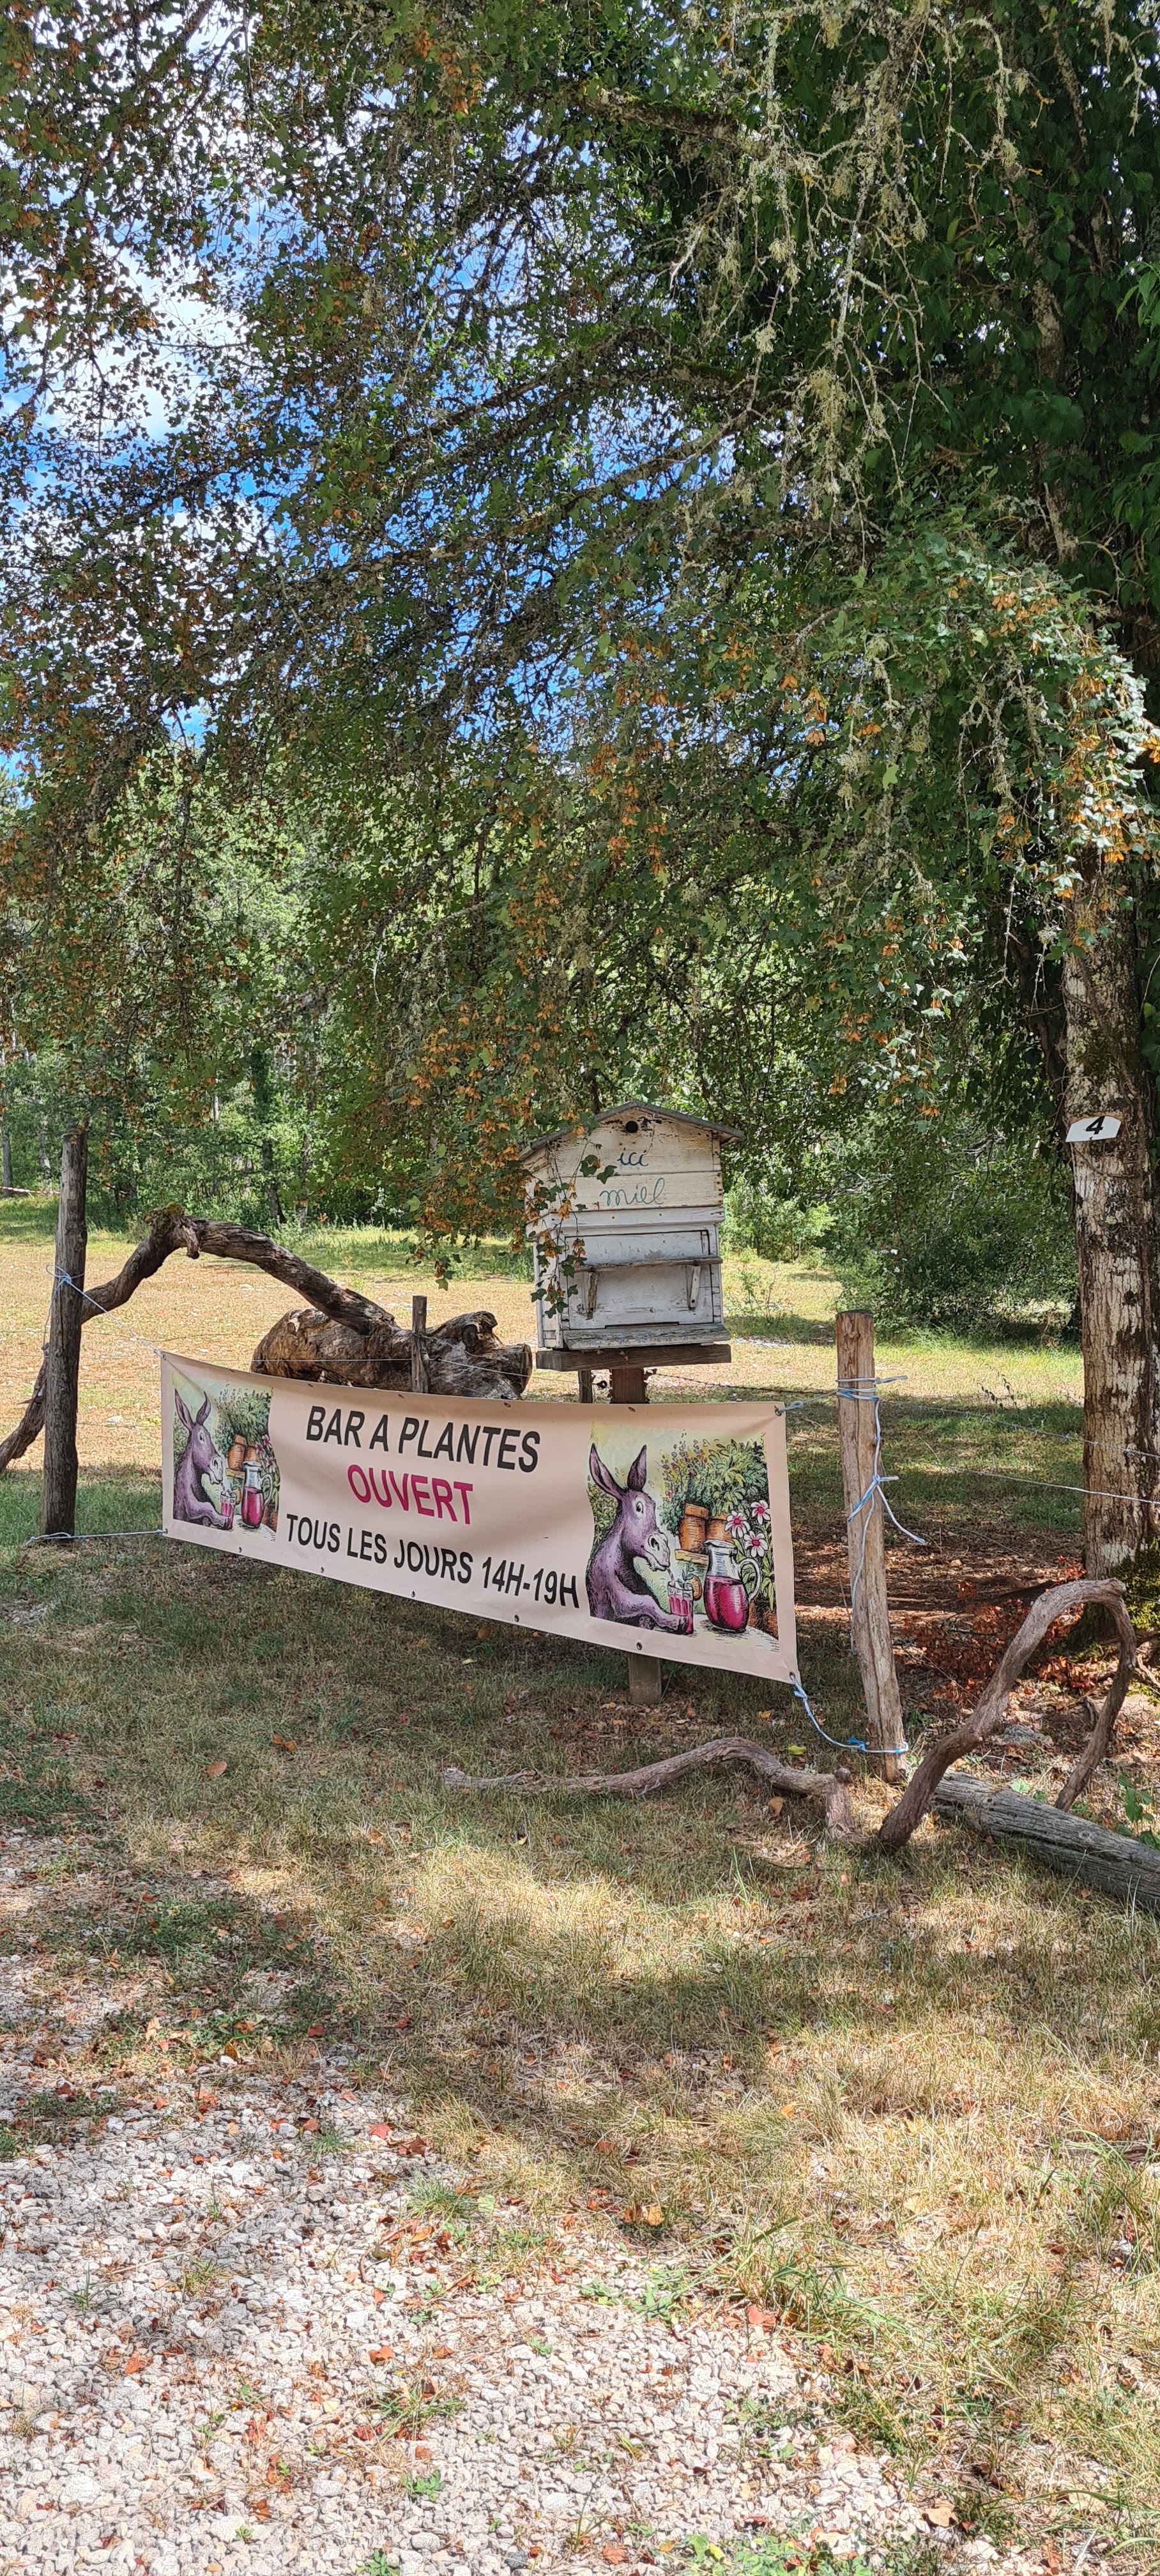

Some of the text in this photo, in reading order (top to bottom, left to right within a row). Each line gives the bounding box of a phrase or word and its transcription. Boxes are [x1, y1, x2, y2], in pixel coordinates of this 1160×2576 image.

[1085, 1116, 1106, 1135] 4
[616, 1147, 649, 1167] ici
[600, 1177, 665, 1206] miel
[306, 1406, 542, 1473] BAR A PLANTES
[347, 1464, 473, 1525] OUVERT
[286, 1514, 580, 1609] TOUS LES JOURS 14H-19H
